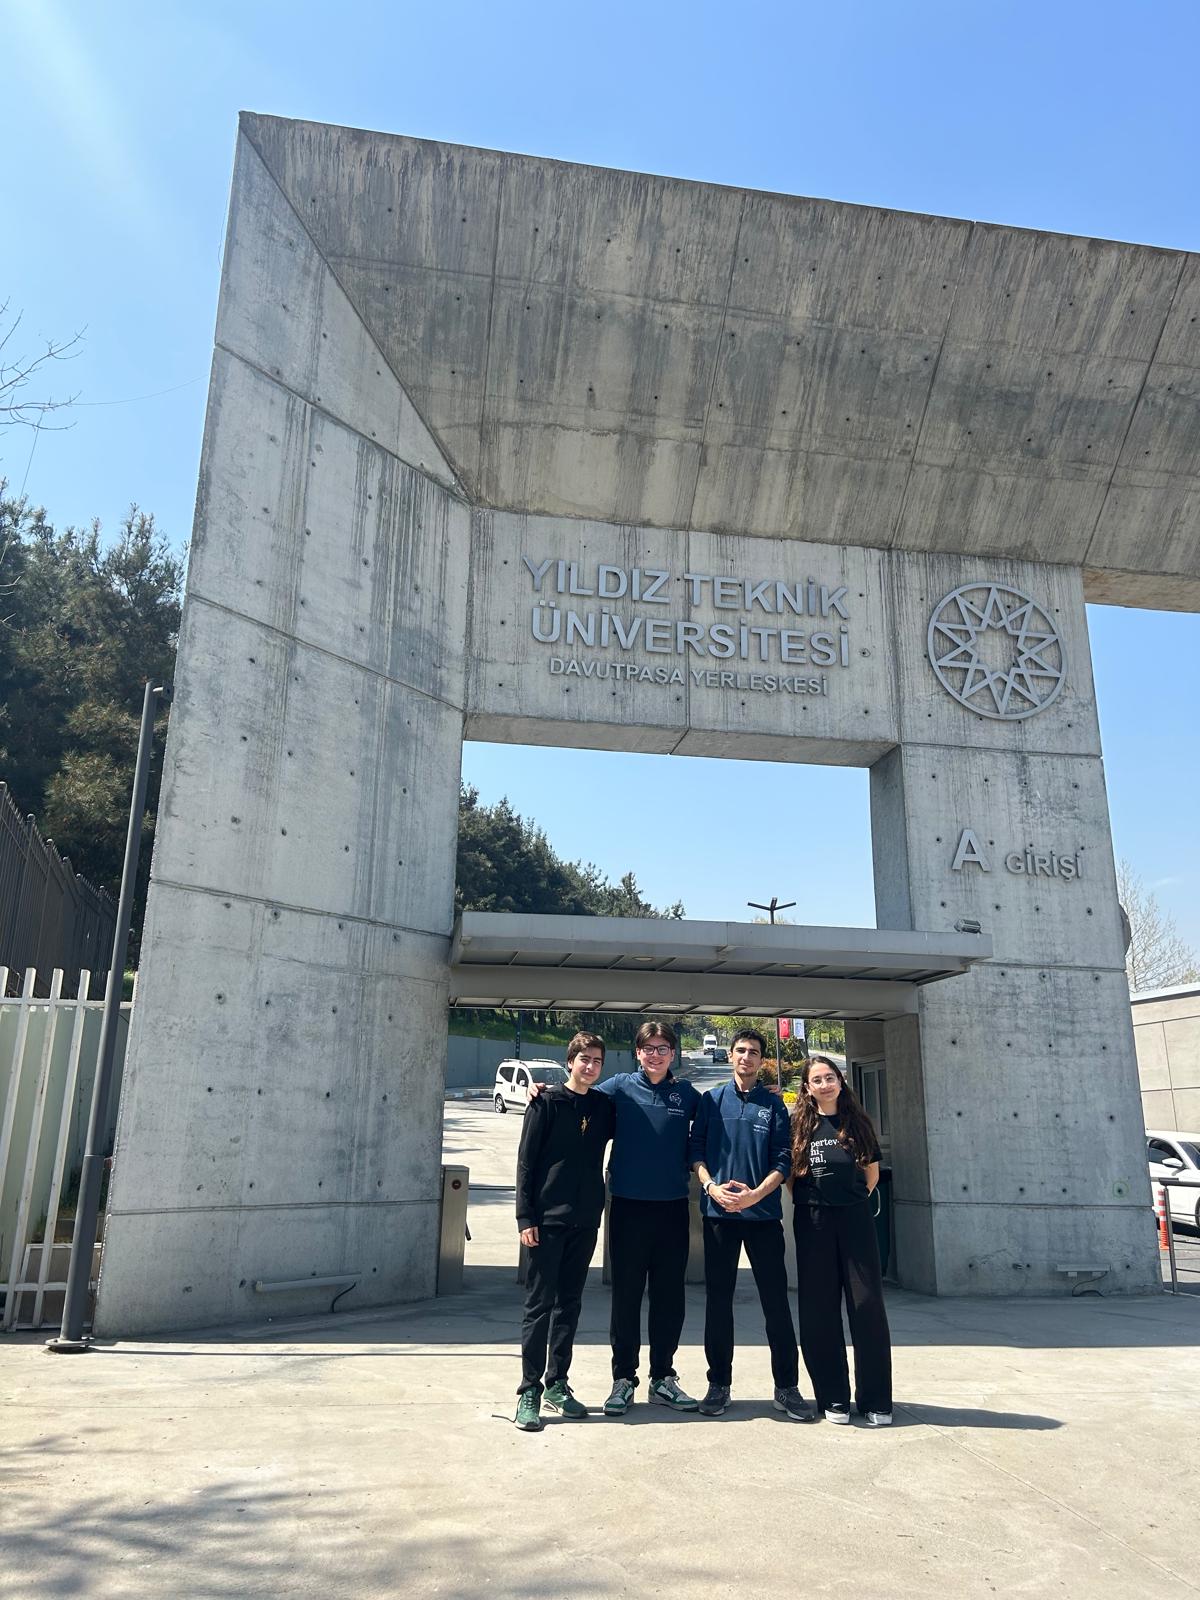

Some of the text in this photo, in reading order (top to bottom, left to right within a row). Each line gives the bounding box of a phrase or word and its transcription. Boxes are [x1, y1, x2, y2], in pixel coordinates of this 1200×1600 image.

[523, 556, 850, 619] YILDIZ TEKNİK
[532, 599, 850, 667] ÜNİVERSİTESİ
[690, 668, 828, 697] YERLEŞKESİ
[951, 829, 1082, 882] A GİRİŞİ
